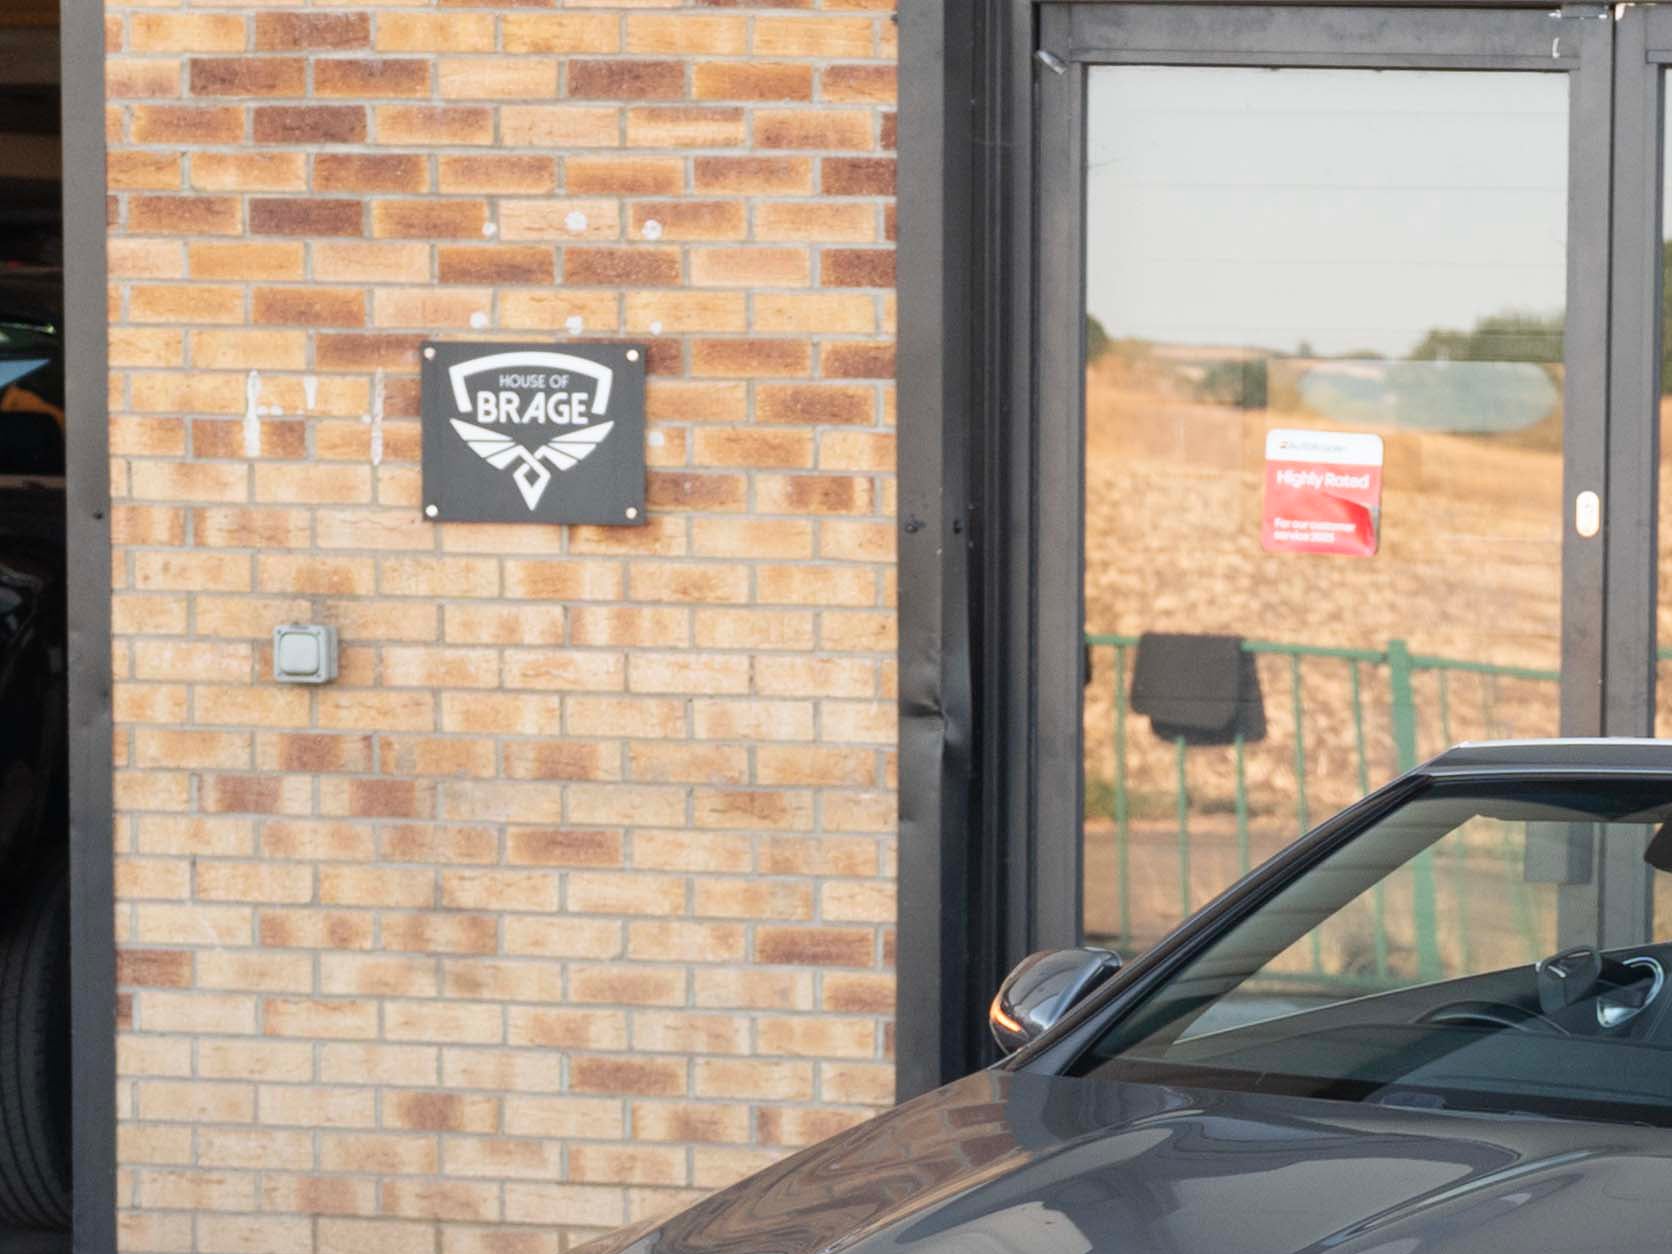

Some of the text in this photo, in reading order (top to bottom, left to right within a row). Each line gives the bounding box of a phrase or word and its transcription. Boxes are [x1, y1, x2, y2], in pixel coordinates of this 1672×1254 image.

[499, 374, 570, 388] HOUSE OF
[476, 390, 589, 425] BRAGE
[1275, 469, 1370, 490] Highly Rated
